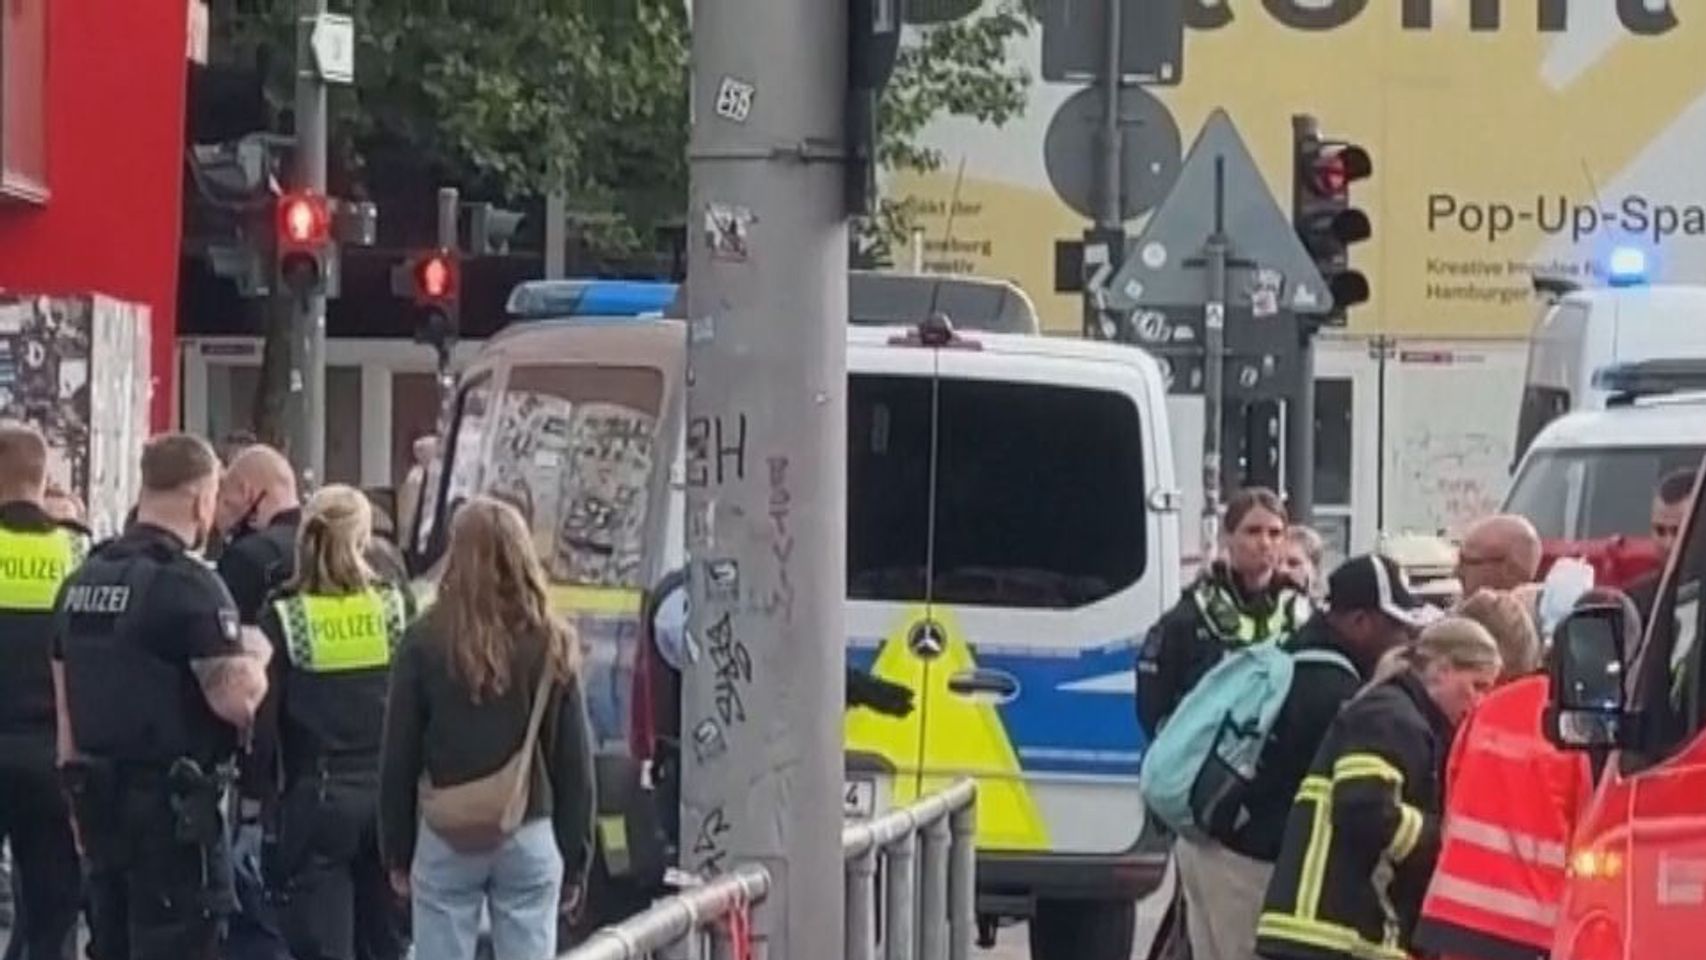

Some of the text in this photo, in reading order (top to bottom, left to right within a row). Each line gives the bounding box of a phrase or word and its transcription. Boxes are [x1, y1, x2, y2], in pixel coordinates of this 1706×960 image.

[1427, 257, 1503, 276] Kreative
[0, 557, 65, 580] OLIZEI
[63, 584, 131, 613] POLIZEI
[312, 613, 382, 641] POLIZEI
